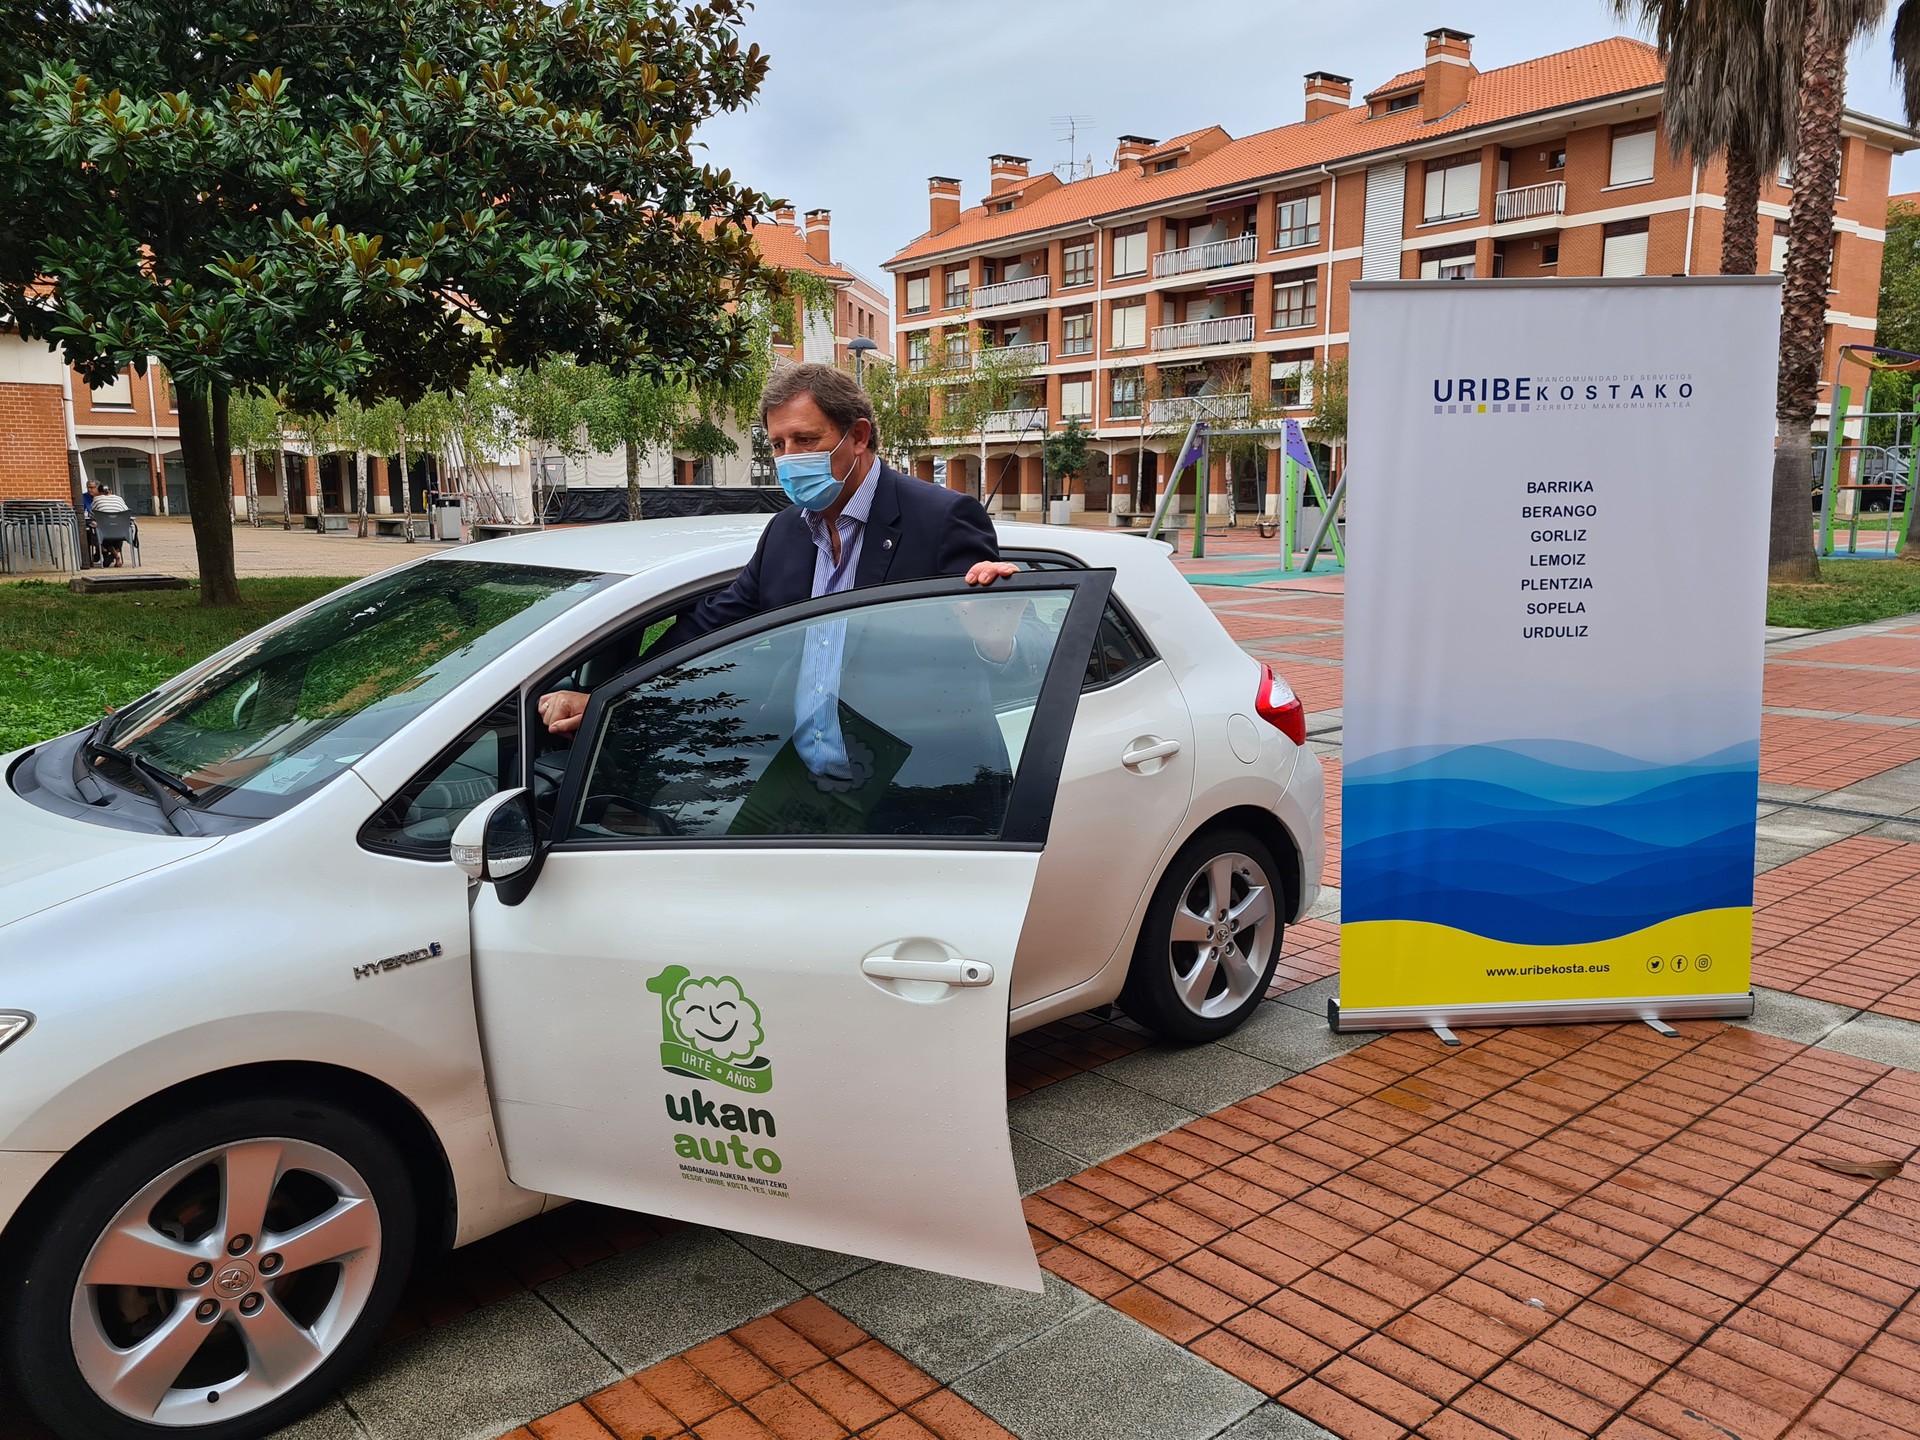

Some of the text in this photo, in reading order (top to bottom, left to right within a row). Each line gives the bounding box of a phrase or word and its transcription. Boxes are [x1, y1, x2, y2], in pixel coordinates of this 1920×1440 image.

[1536, 375, 1618, 383] MANCOMUNIDAD
[1640, 373, 1693, 381] SERVICIOS
[1433, 377, 1531, 402] URIBE
[1536, 383, 1693, 401] KOSTAKO
[1535, 401, 1691, 411] ZERBITZU MANKOMUNITATEA
[1527, 480, 1594, 494] BARRIKA
[1522, 504, 1597, 518] BERANGO
[1530, 529, 1587, 543] GORLIZ
[1530, 553, 1586, 567] LEMOIZ
[1521, 577, 1593, 591] PLENTZIA
[1526, 601, 1586, 615] SOPELA
[1523, 625, 1589, 639] URDULIZ
[352, 947, 429, 980] HYBRID
[1486, 963, 1610, 977] www.uribekosta.eus
[681, 1051, 757, 1089] URTE AÑOS
[665, 1089, 776, 1138] ukan
[673, 1133, 782, 1175] auto
[679, 1163, 788, 1190] BADAUKAGU AUKERA MUGITZEKO
[681, 1172, 703, 1183] DESDE
[704, 1177, 725, 1187] URIBE
